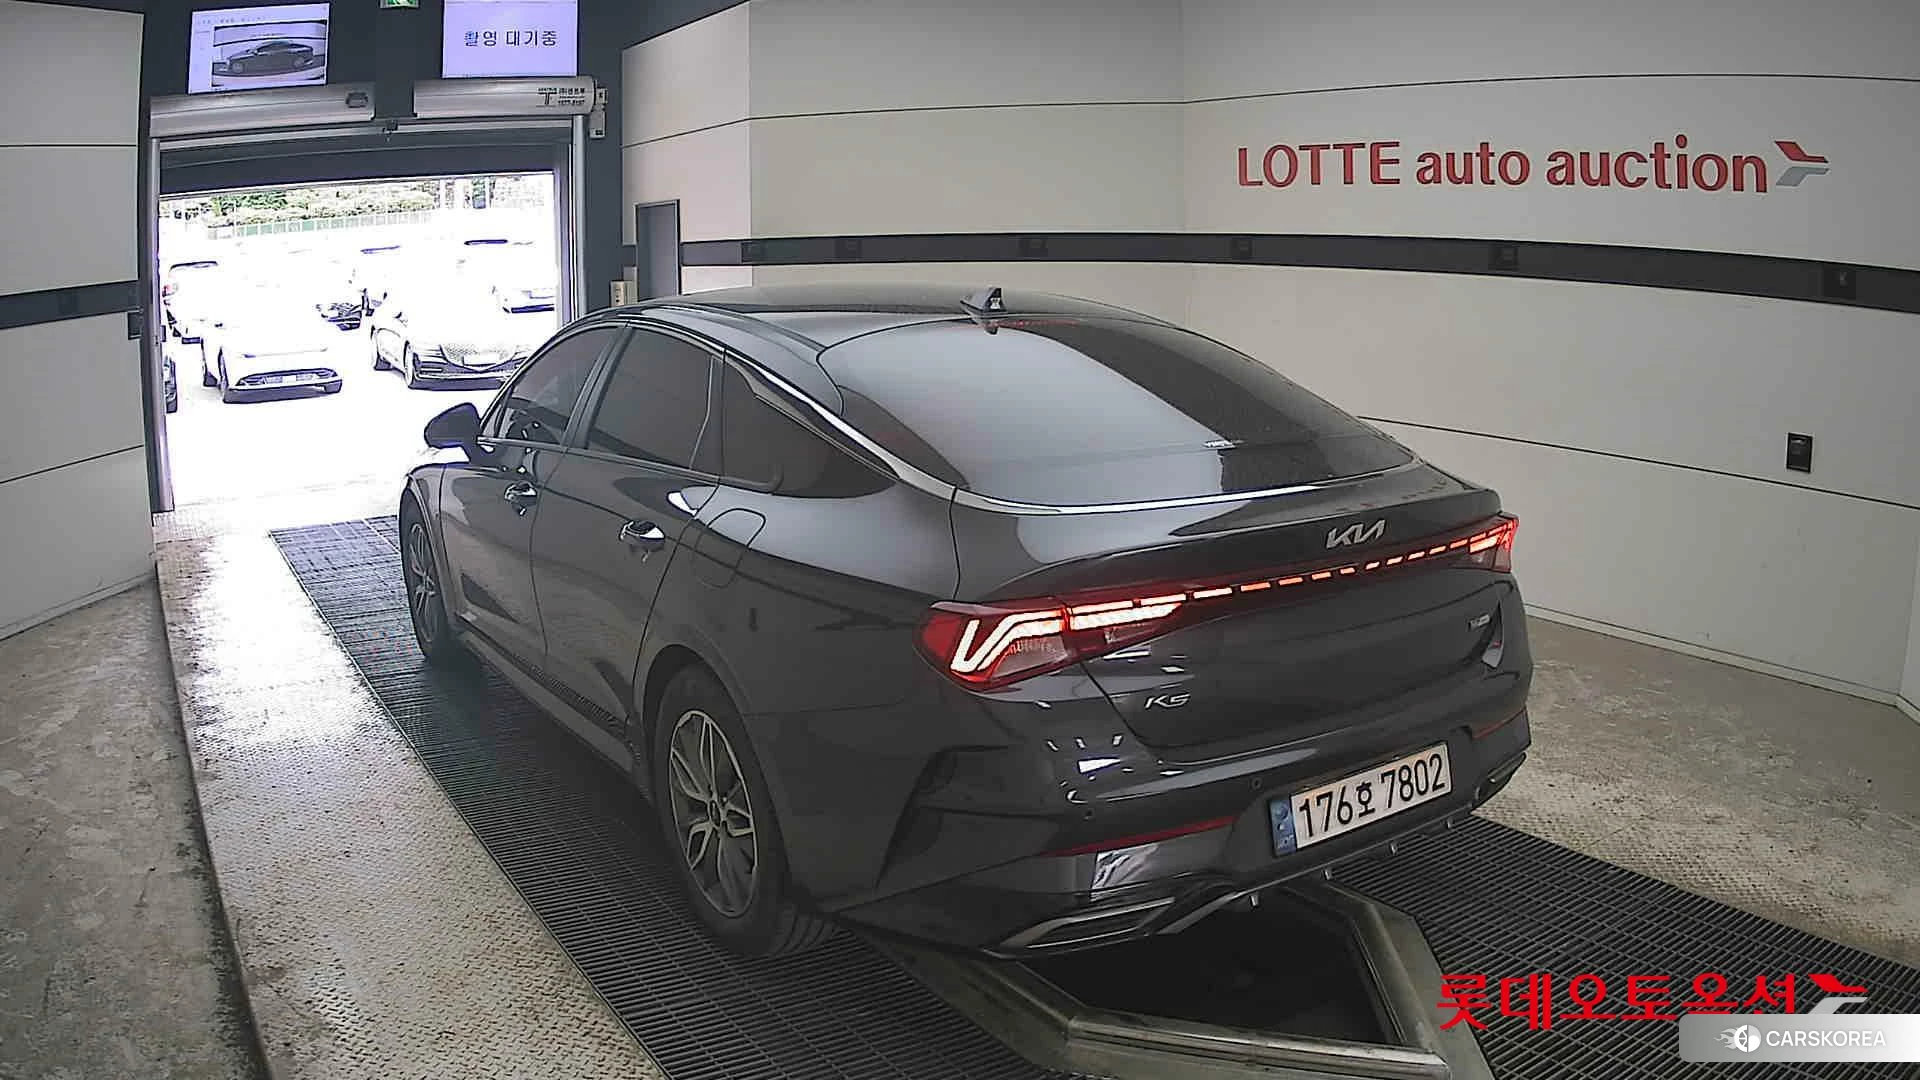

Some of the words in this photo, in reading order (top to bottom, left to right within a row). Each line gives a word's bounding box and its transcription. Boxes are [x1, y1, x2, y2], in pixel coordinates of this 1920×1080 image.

[505, 30, 557, 47] 대기중
[1238, 141, 1400, 187] LOTTE
[1416, 141, 1530, 185] auto
[1546, 134, 1767, 193] auction
[1326, 519, 1386, 549] KIA
[1144, 693, 1191, 709] K5
[1298, 781, 1376, 838] 176호
[1380, 753, 1446, 809] 7802
